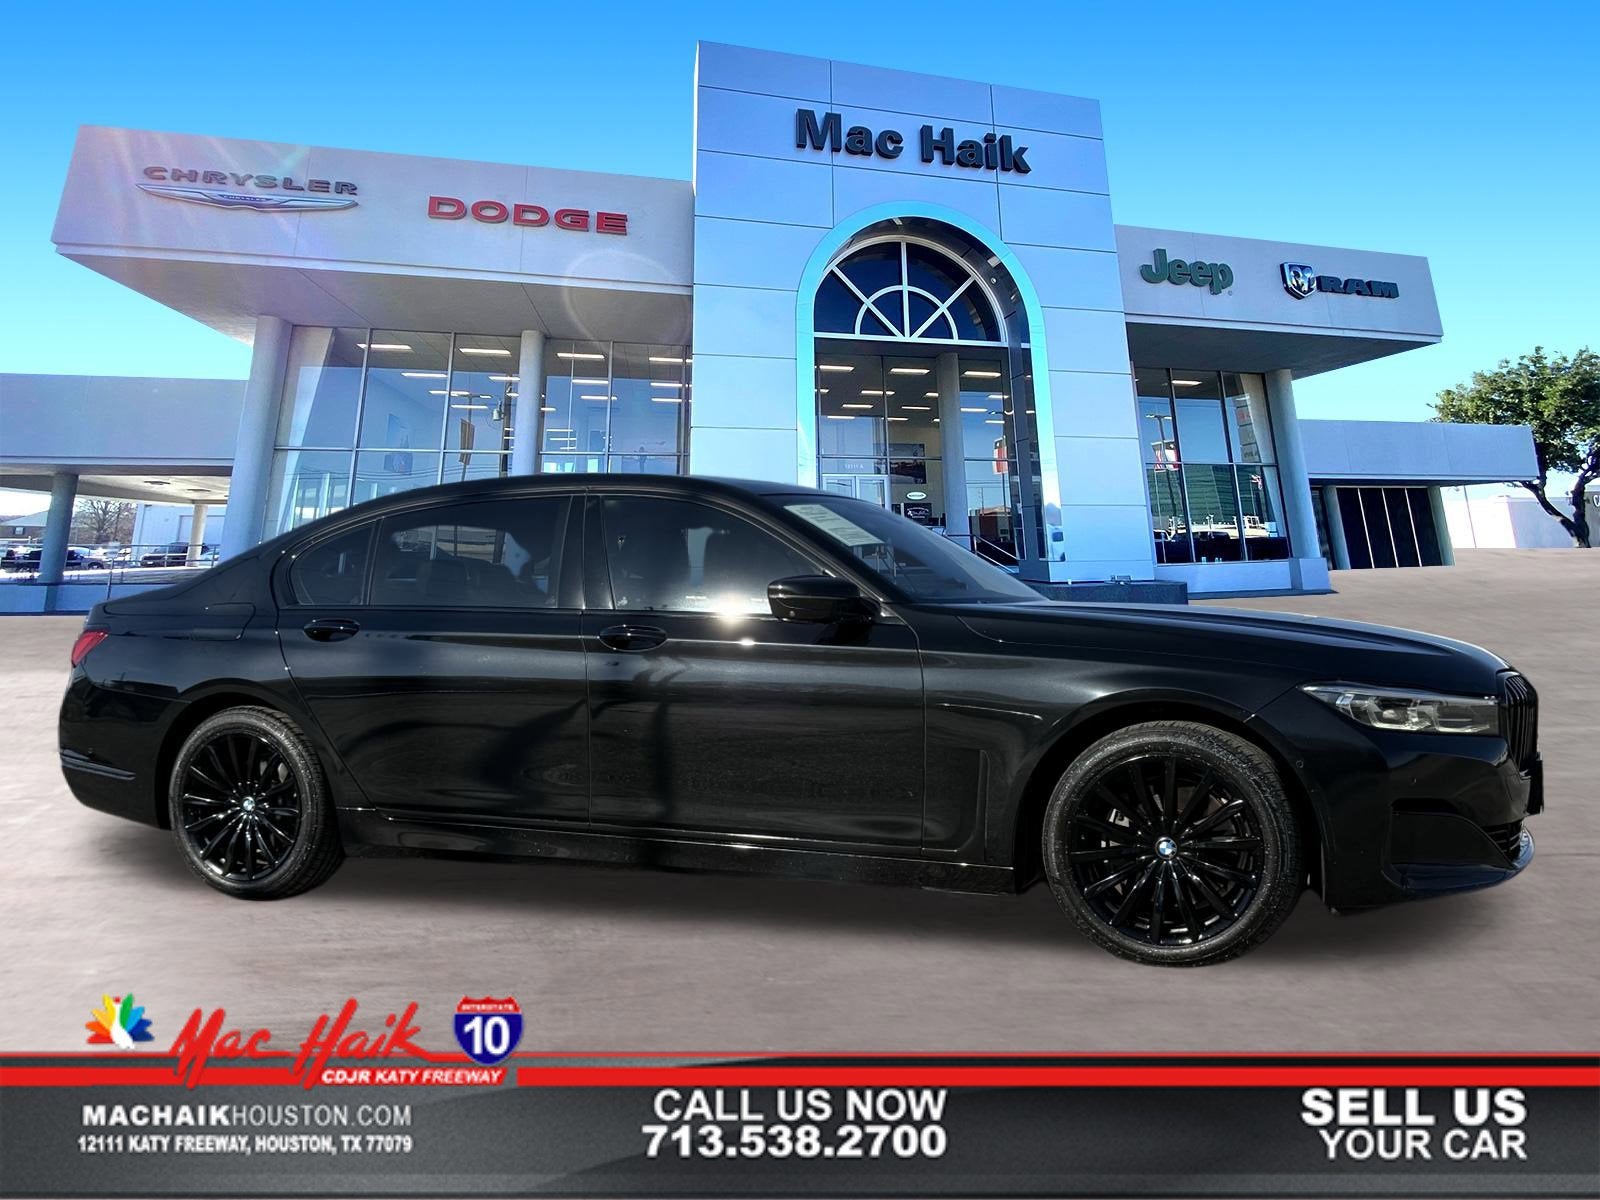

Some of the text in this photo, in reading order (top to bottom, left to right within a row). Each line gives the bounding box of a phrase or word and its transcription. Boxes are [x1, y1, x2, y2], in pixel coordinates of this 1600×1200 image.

[795, 107, 1032, 174] Mac Haik
[143, 166, 358, 195] CHRYSLER
[428, 195, 628, 236] DODGE
[1139, 248, 1234, 296] Jeep
[1316, 275, 1400, 299] RAM
